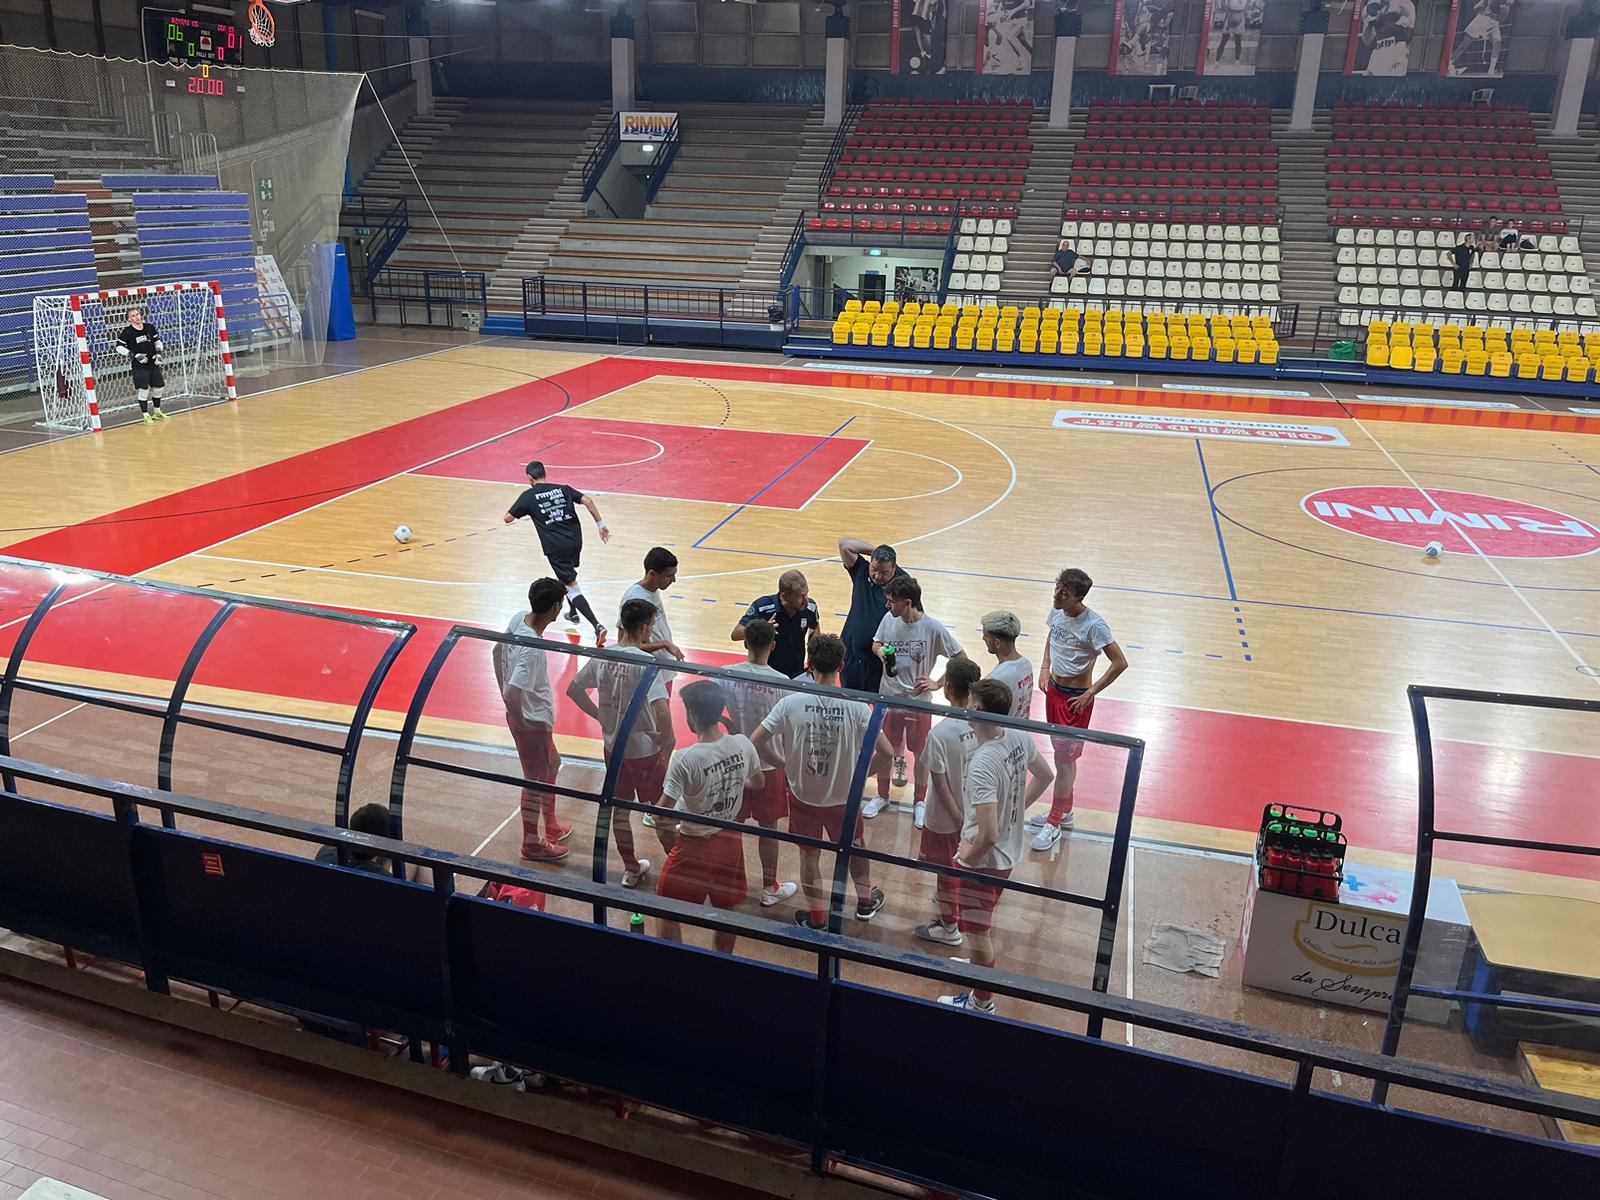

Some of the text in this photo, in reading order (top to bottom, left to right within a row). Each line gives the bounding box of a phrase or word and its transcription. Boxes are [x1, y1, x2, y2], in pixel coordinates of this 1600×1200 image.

[624, 115, 674, 129] RIMINI
[1312, 501, 1596, 538] RIMINI
[804, 704, 845, 716] rimini
[703, 750, 744, 777] rimini
[1314, 909, 1401, 945] Dulca
[1291, 971, 1317, 984] da
